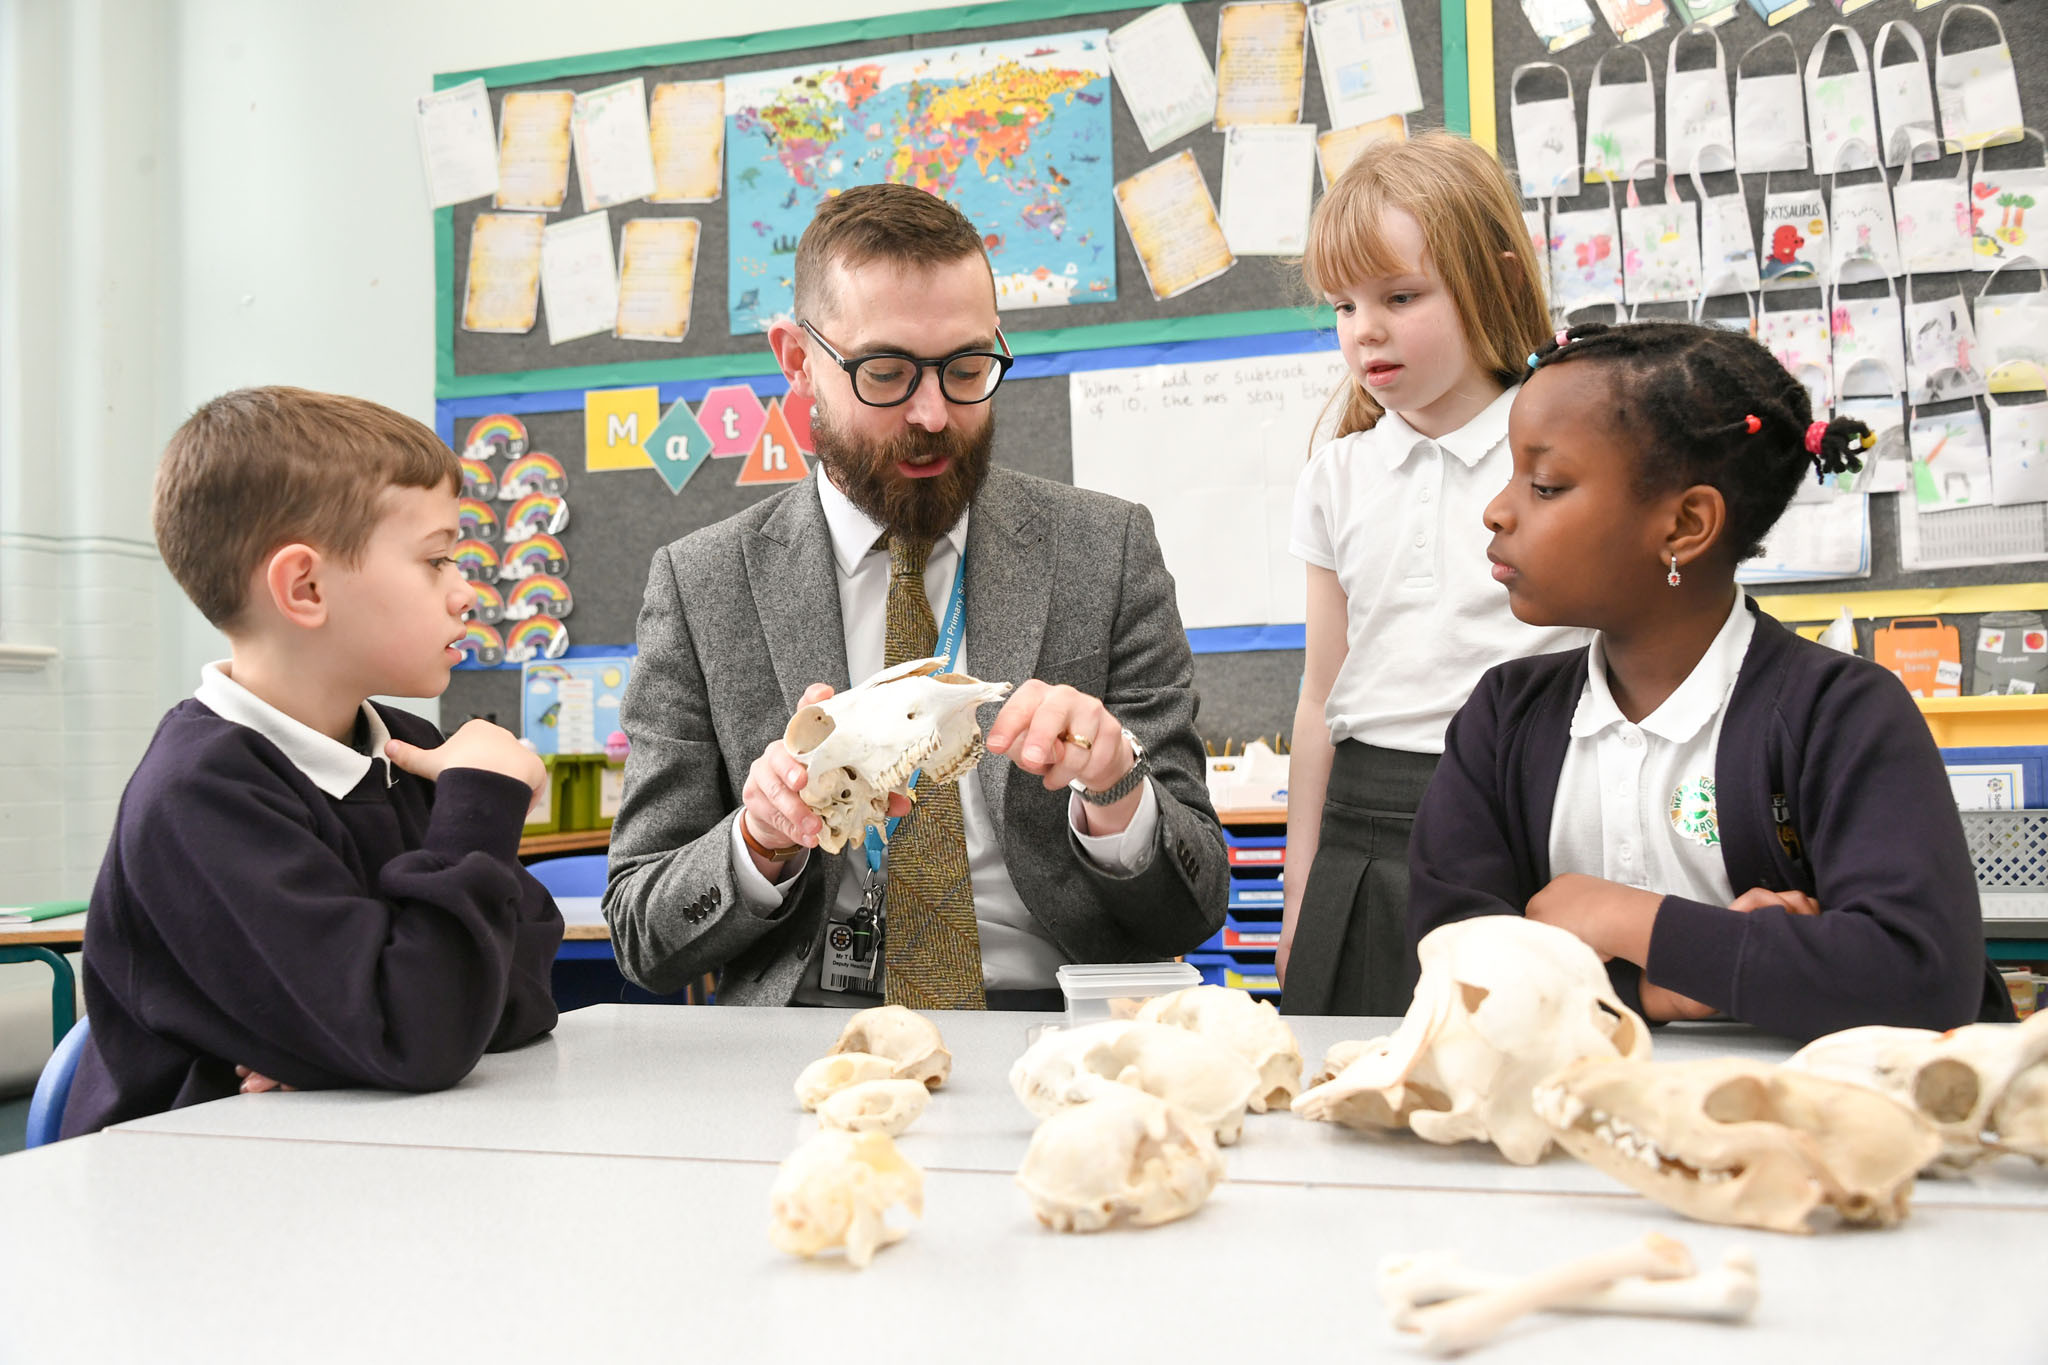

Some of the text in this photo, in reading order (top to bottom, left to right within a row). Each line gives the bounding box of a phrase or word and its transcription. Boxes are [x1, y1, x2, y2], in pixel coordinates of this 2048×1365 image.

[1204, 373, 1219, 385] or
[1247, 388, 1284, 410] stay
[607, 404, 817, 472] Math
[947, 597, 965, 637] Primary
[832, 960, 850, 968] Deputy
